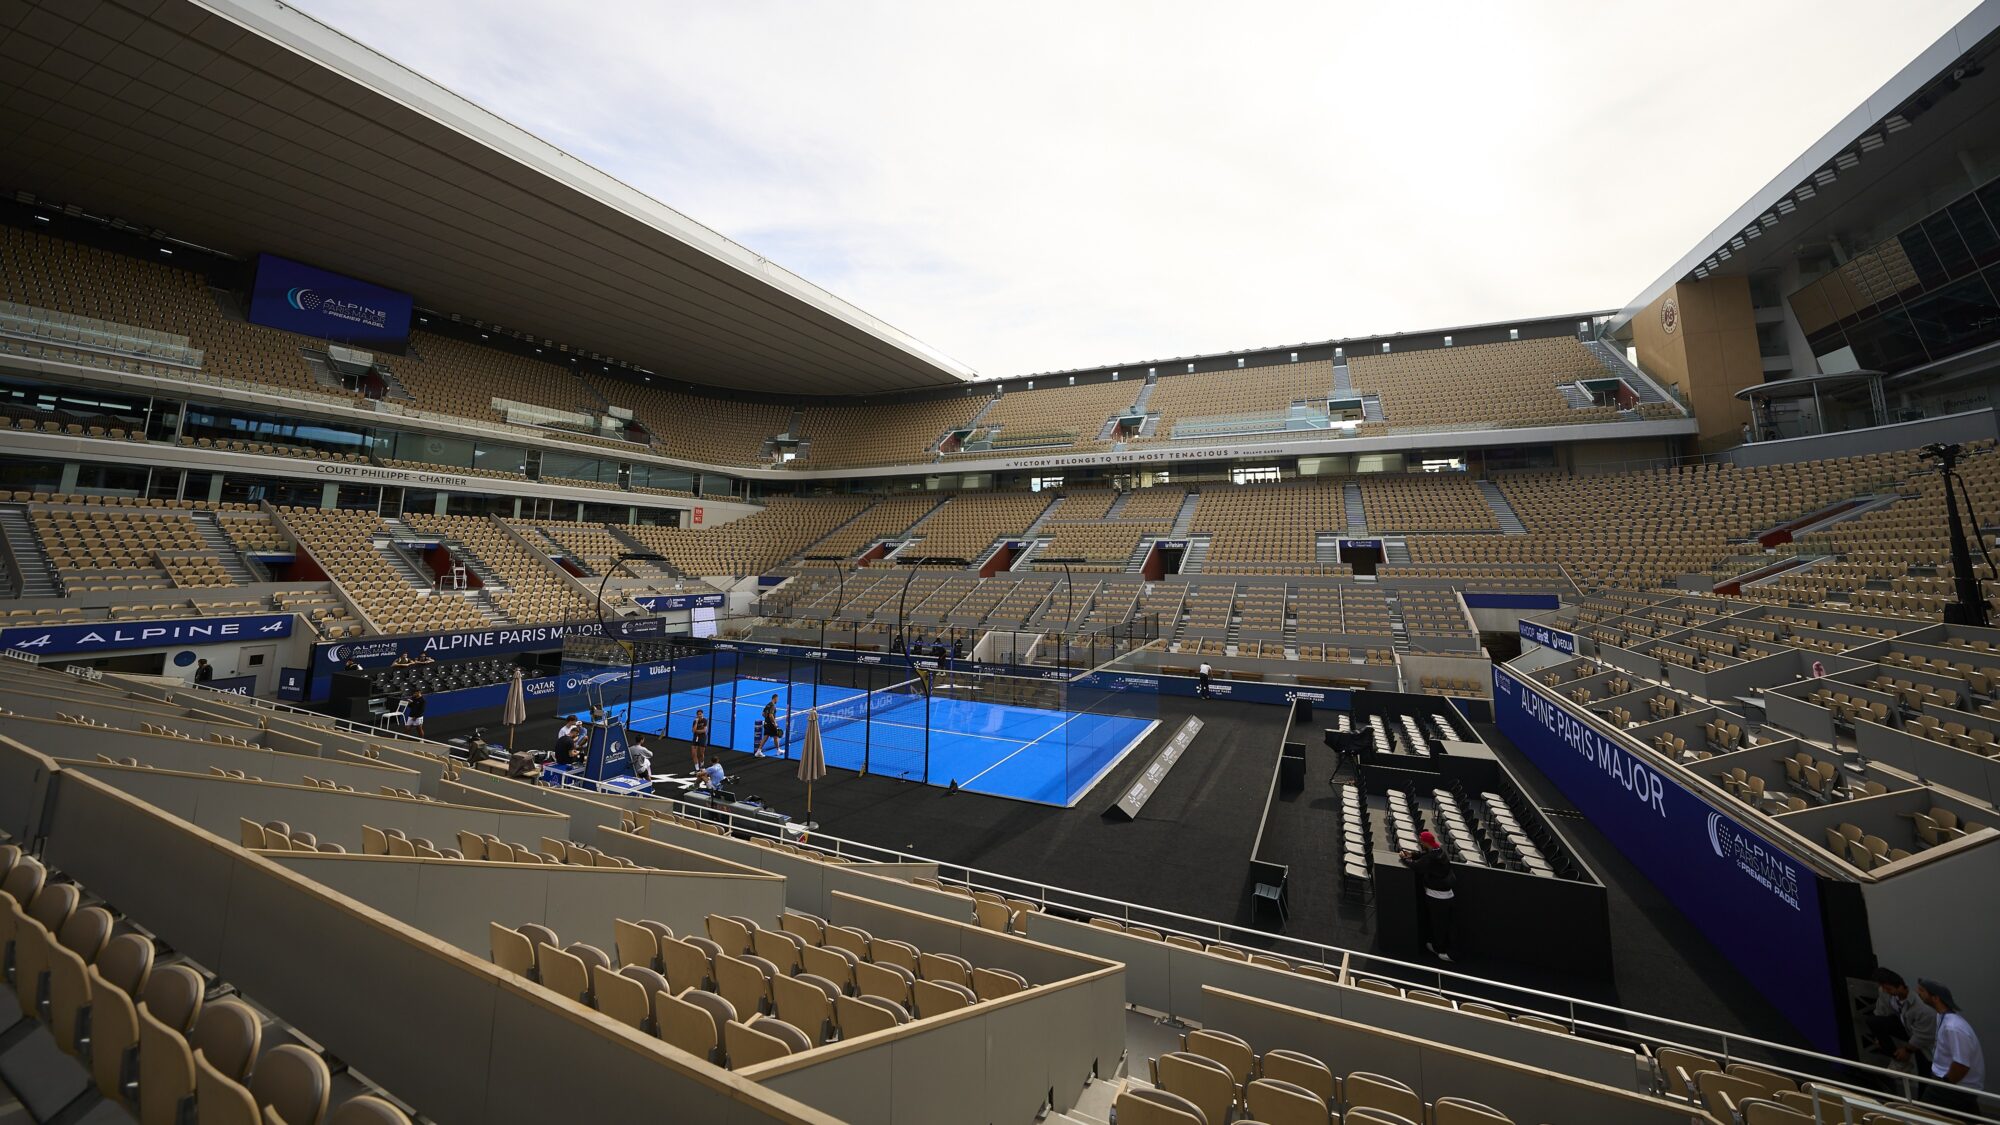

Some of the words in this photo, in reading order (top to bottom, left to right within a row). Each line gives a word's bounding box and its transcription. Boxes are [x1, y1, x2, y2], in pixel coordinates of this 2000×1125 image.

[323, 302, 350, 316] PARIS
[351, 310, 385, 323] MAJOR
[324, 298, 387, 318] ALPINE
[328, 310, 361, 323] PREMIER
[362, 319, 385, 329] PADEL
[1014, 459, 1051, 467] VICTORY
[1055, 457, 1096, 465] BELONGS
[1116, 454, 1134, 462] THE
[1169, 449, 1229, 459] TENACIOUS
[316, 464, 359, 477] COURT
[361, 469, 410, 481] PHILIPPE
[418, 474, 467, 486] CHATRIER
[76, 623, 240, 645] ALPINE
[424, 631, 494, 651] ALPINE
[499, 627, 546, 644] PARIS
[550, 623, 603, 639] MAJOR
[1557, 638, 1574, 651] VEOLIA
[353, 642, 398, 650] ALPINE
[526, 681, 555, 693] QATAR
[1521, 687, 1556, 733] ALPINE
[1557, 710, 1594, 762] PARIS
[1597, 736, 1667, 818] MAJOR
[1734, 833, 1797, 884] ALPINE
[1734, 842, 1760, 872] PARIS
[1760, 861, 1800, 900] MAJOR
[1741, 861, 1772, 891] PREMIER
[1774, 885, 1801, 912] PADEL
